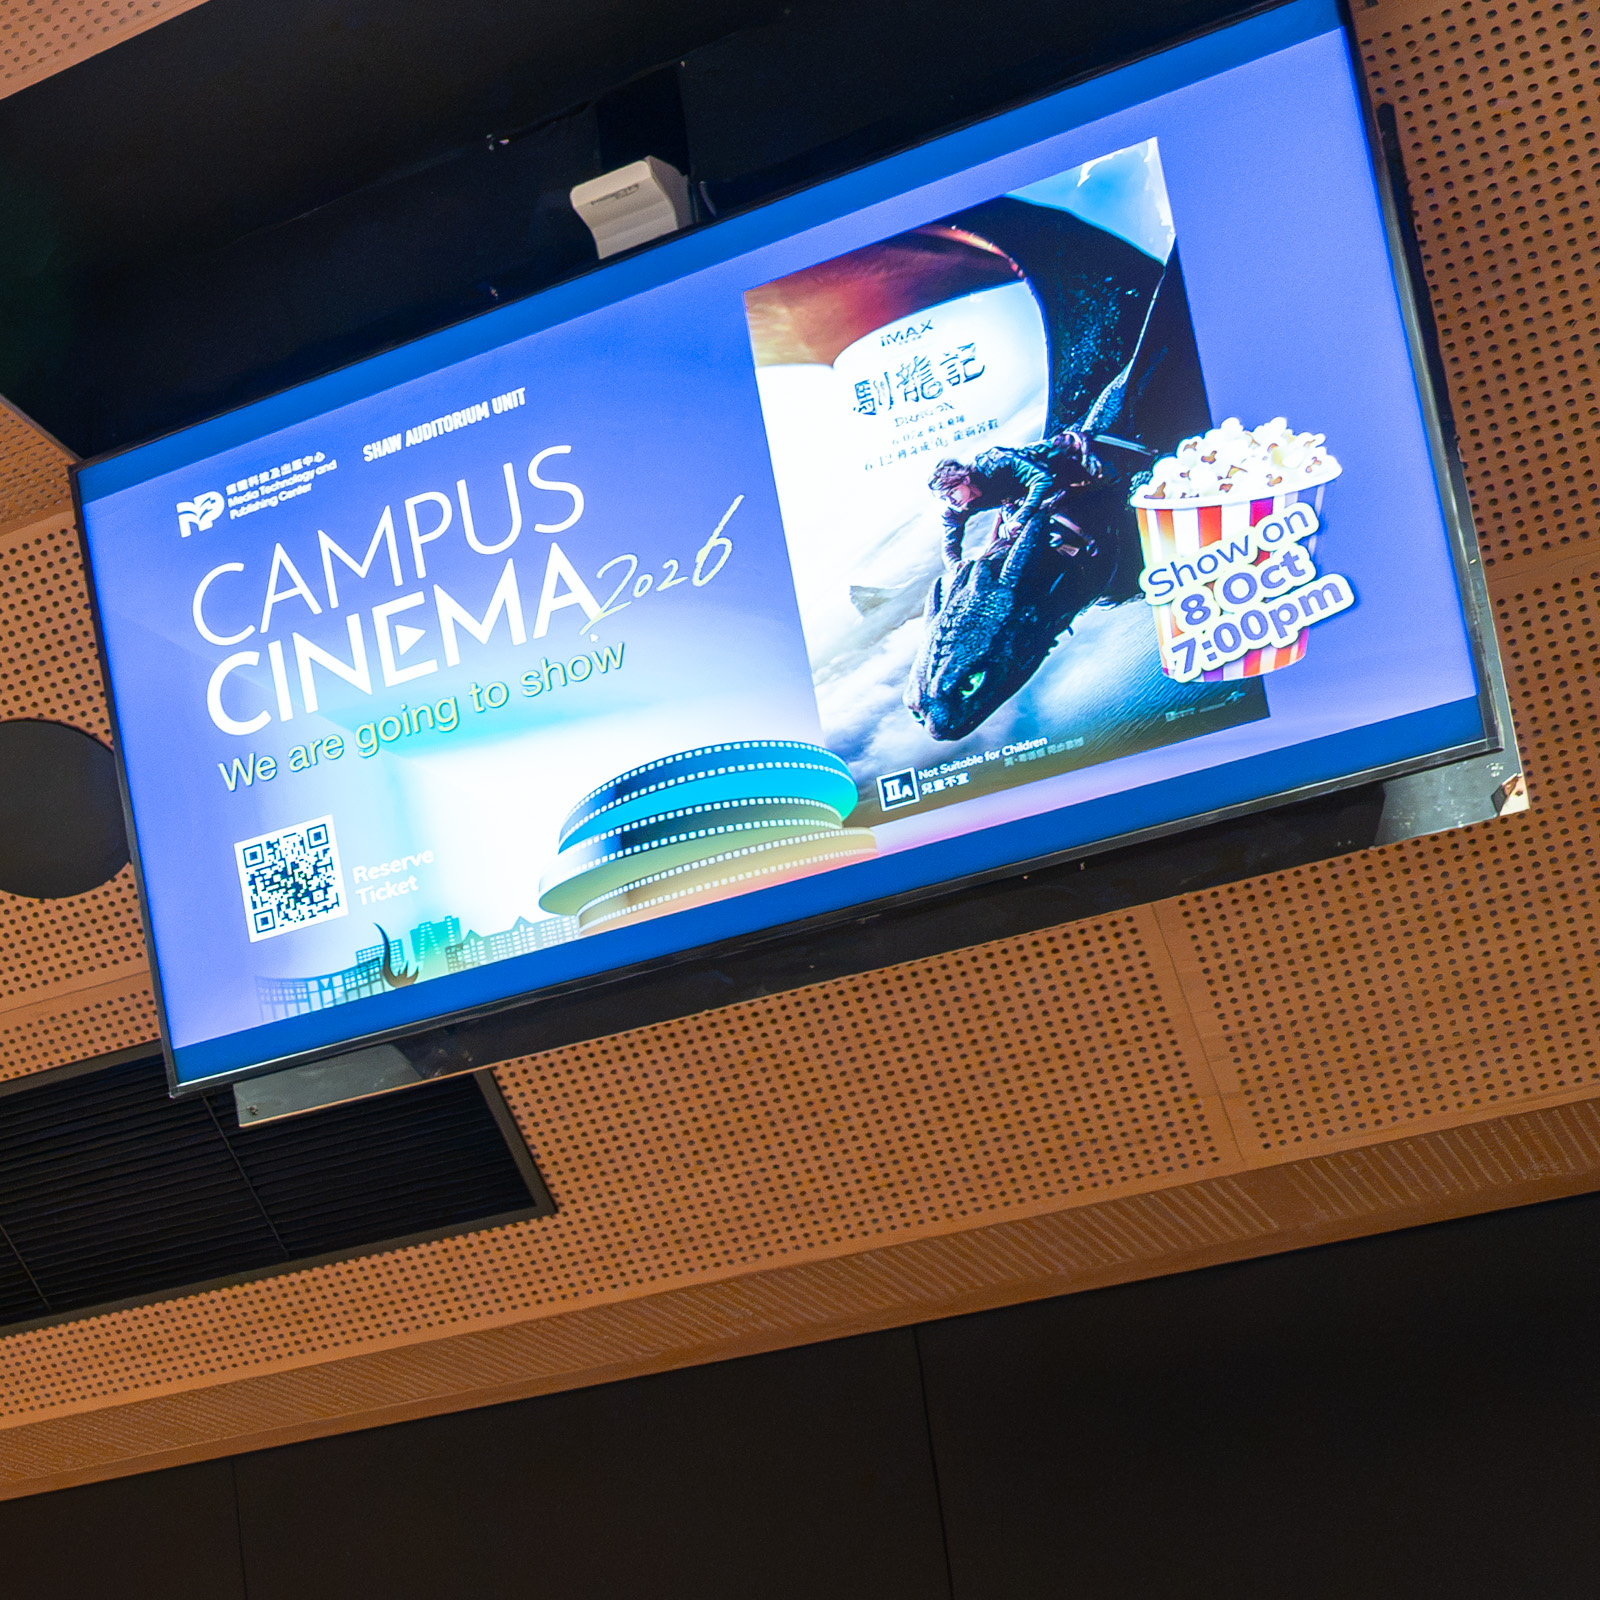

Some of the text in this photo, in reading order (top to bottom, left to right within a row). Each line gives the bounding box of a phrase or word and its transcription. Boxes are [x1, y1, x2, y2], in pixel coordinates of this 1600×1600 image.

[363, 387, 527, 462] SHAW AUDITORIUM UNIT
[228, 459, 338, 508] Media Technology and
[193, 445, 586, 646] CAMPUS
[1148, 509, 1309, 597] Show on
[207, 494, 745, 736] CINEMA 2026
[1181, 550, 1306, 626] 8 Oct
[1172, 583, 1343, 674] 7:00pm
[219, 641, 626, 792] We are going to show
[918, 768, 939, 781] Not
[940, 755, 984, 776] Suitable
[984, 749, 1000, 763] for
[1001, 736, 1048, 757] Children
[352, 850, 435, 885] Reserve
[355, 874, 420, 906] Ticket
